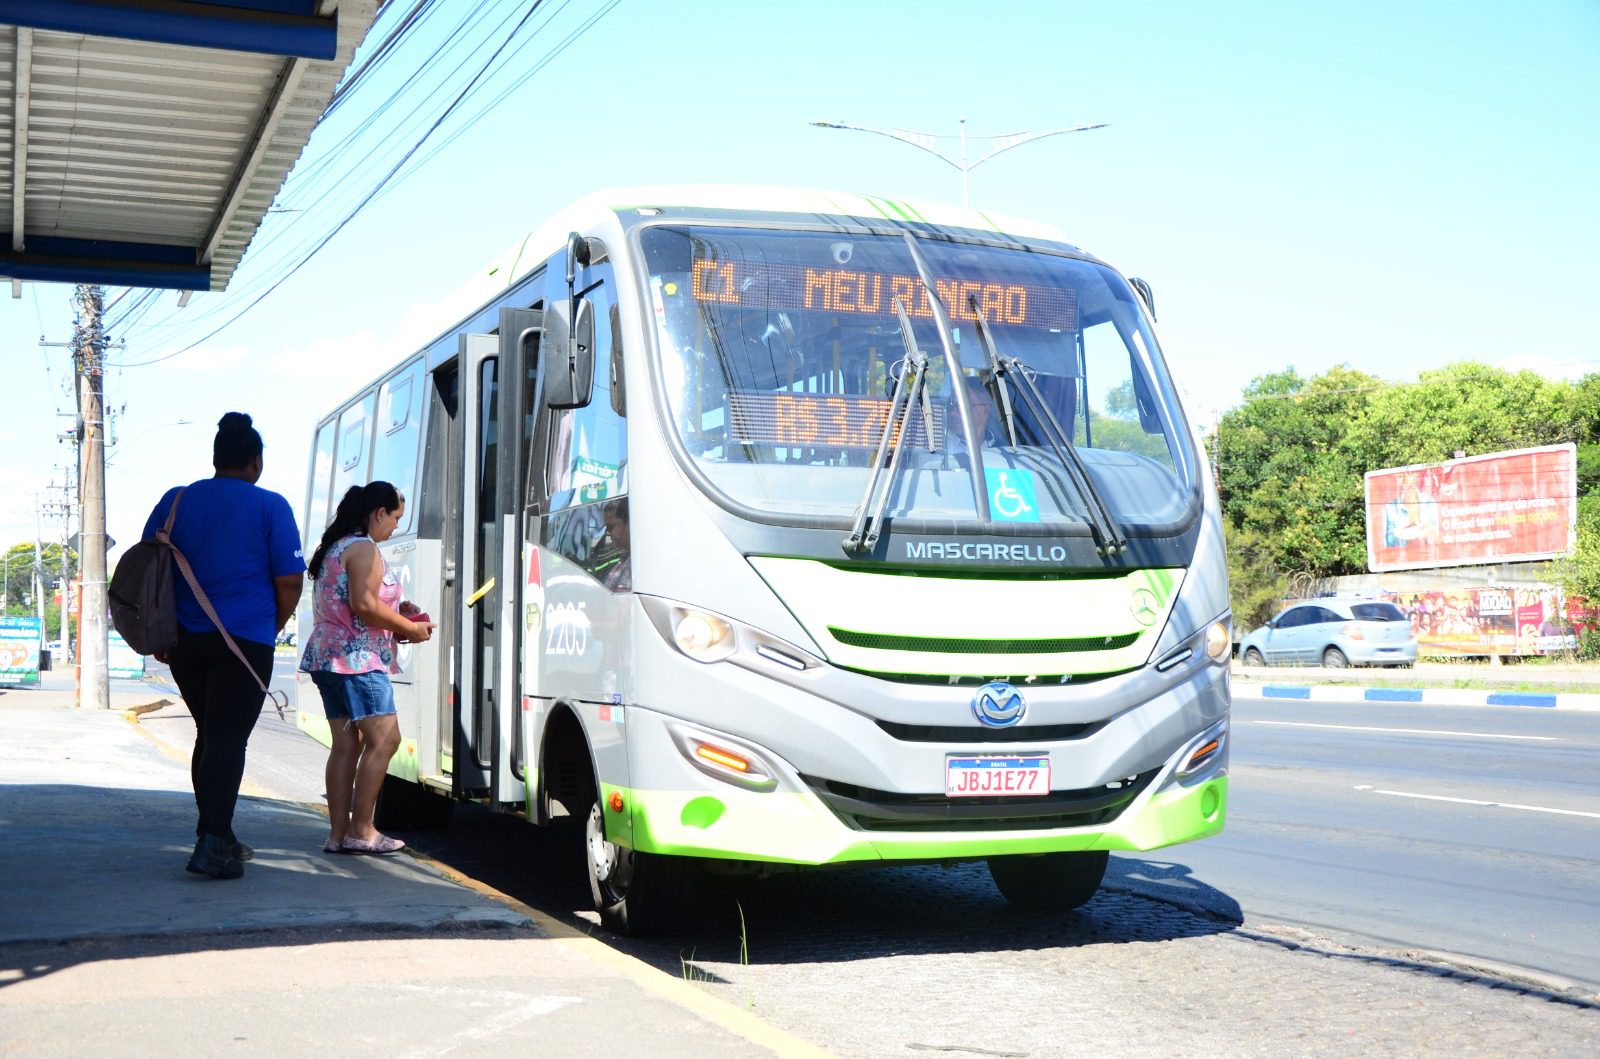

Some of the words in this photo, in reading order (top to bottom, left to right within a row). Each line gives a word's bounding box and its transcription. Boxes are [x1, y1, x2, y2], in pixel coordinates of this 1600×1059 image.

[692, 259, 740, 303] C1
[804, 269, 881, 314] MEU
[776, 396, 818, 444] R$
[906, 541, 1067, 562] MASCARELLO
[545, 601, 587, 656] 2205
[957, 769, 1039, 791] JBJ1E77
